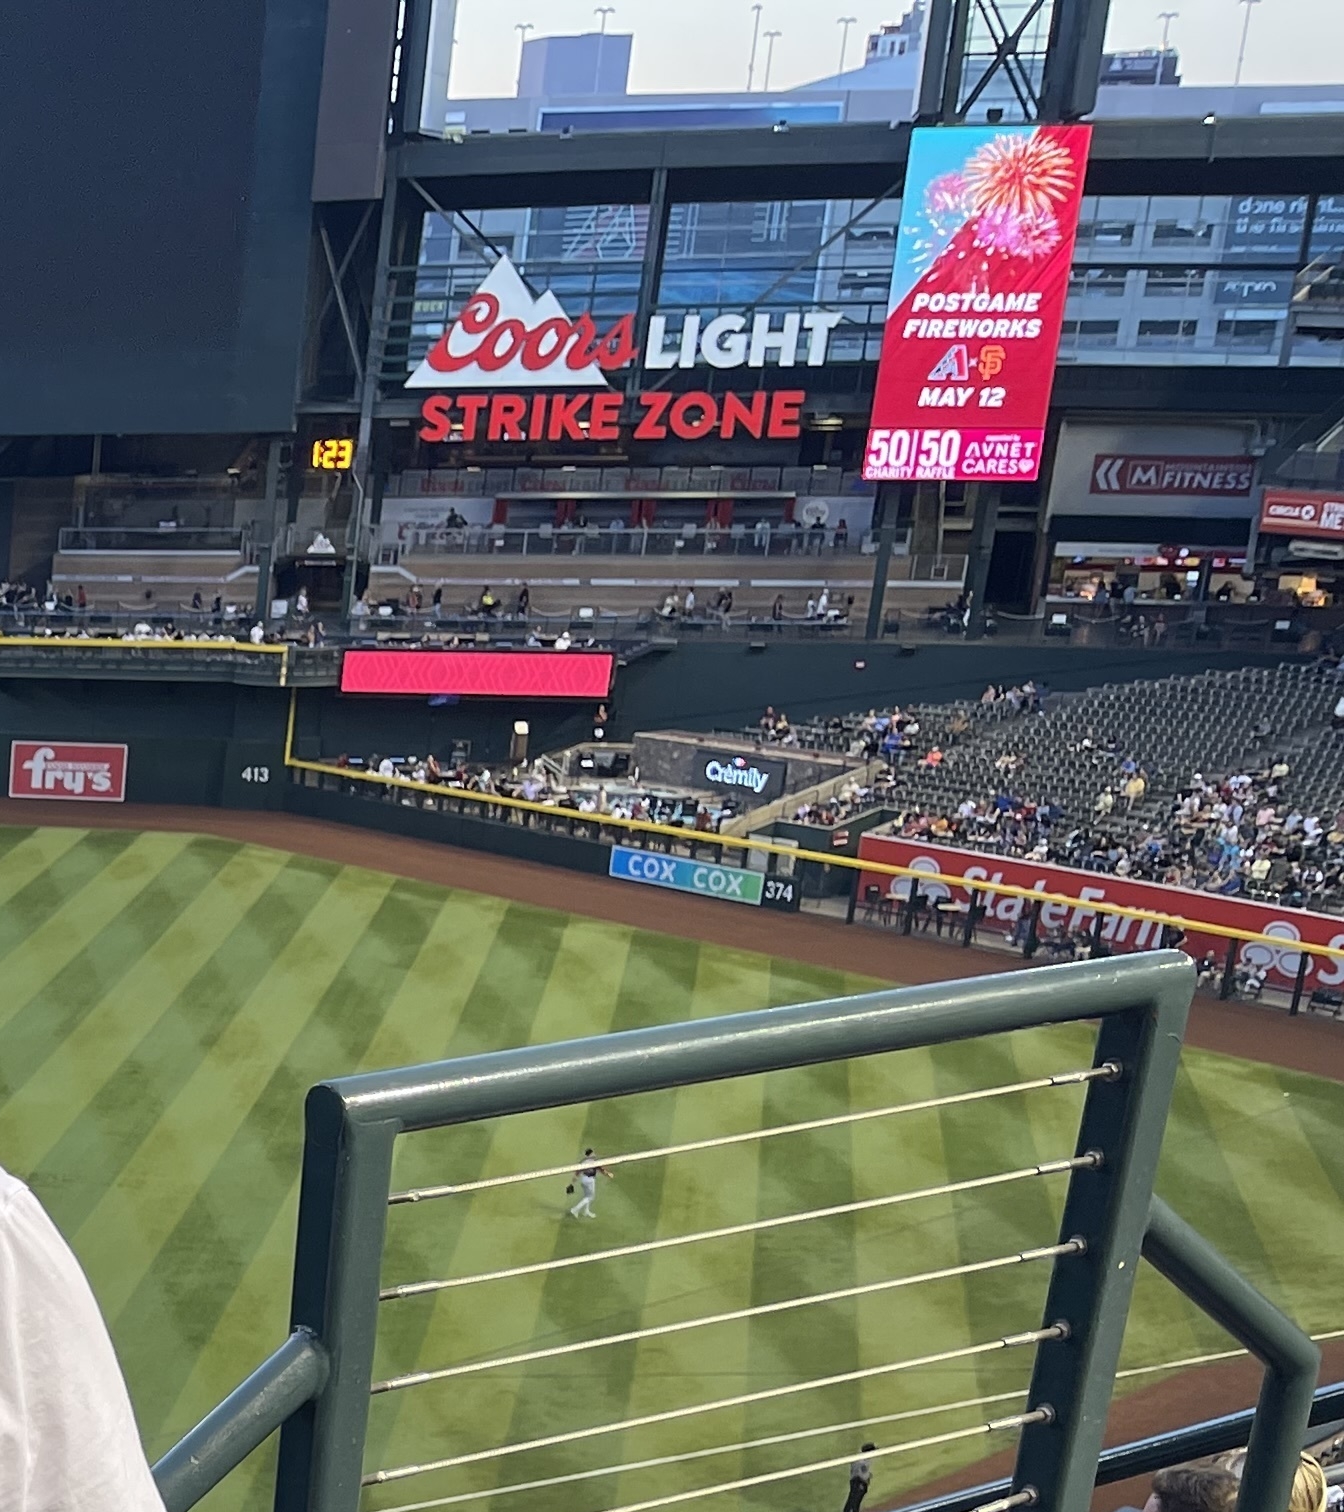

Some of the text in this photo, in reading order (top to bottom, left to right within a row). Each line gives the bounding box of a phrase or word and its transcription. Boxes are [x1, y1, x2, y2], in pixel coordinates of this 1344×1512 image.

[912, 292, 1042, 313] POSTGAME
[427, 293, 638, 373] Coors
[902, 318, 1042, 339] FIREWORKS
[644, 312, 844, 370] LIGHT
[917, 387, 1006, 408] MAY 12
[419, 390, 806, 443] STRIKE ZONE
[313, 439, 354, 469] 1:23
[965, 441, 1036, 458] AVNET
[864, 465, 957, 480] CHARITY RAFFLE
[962, 458, 1018, 475] CARES
[1162, 470, 1251, 490] FITNESS
[22, 747, 112, 794] fry's
[241, 766, 270, 783] 413
[628, 854, 744, 896] COX COX
[764, 880, 794, 903] 374
